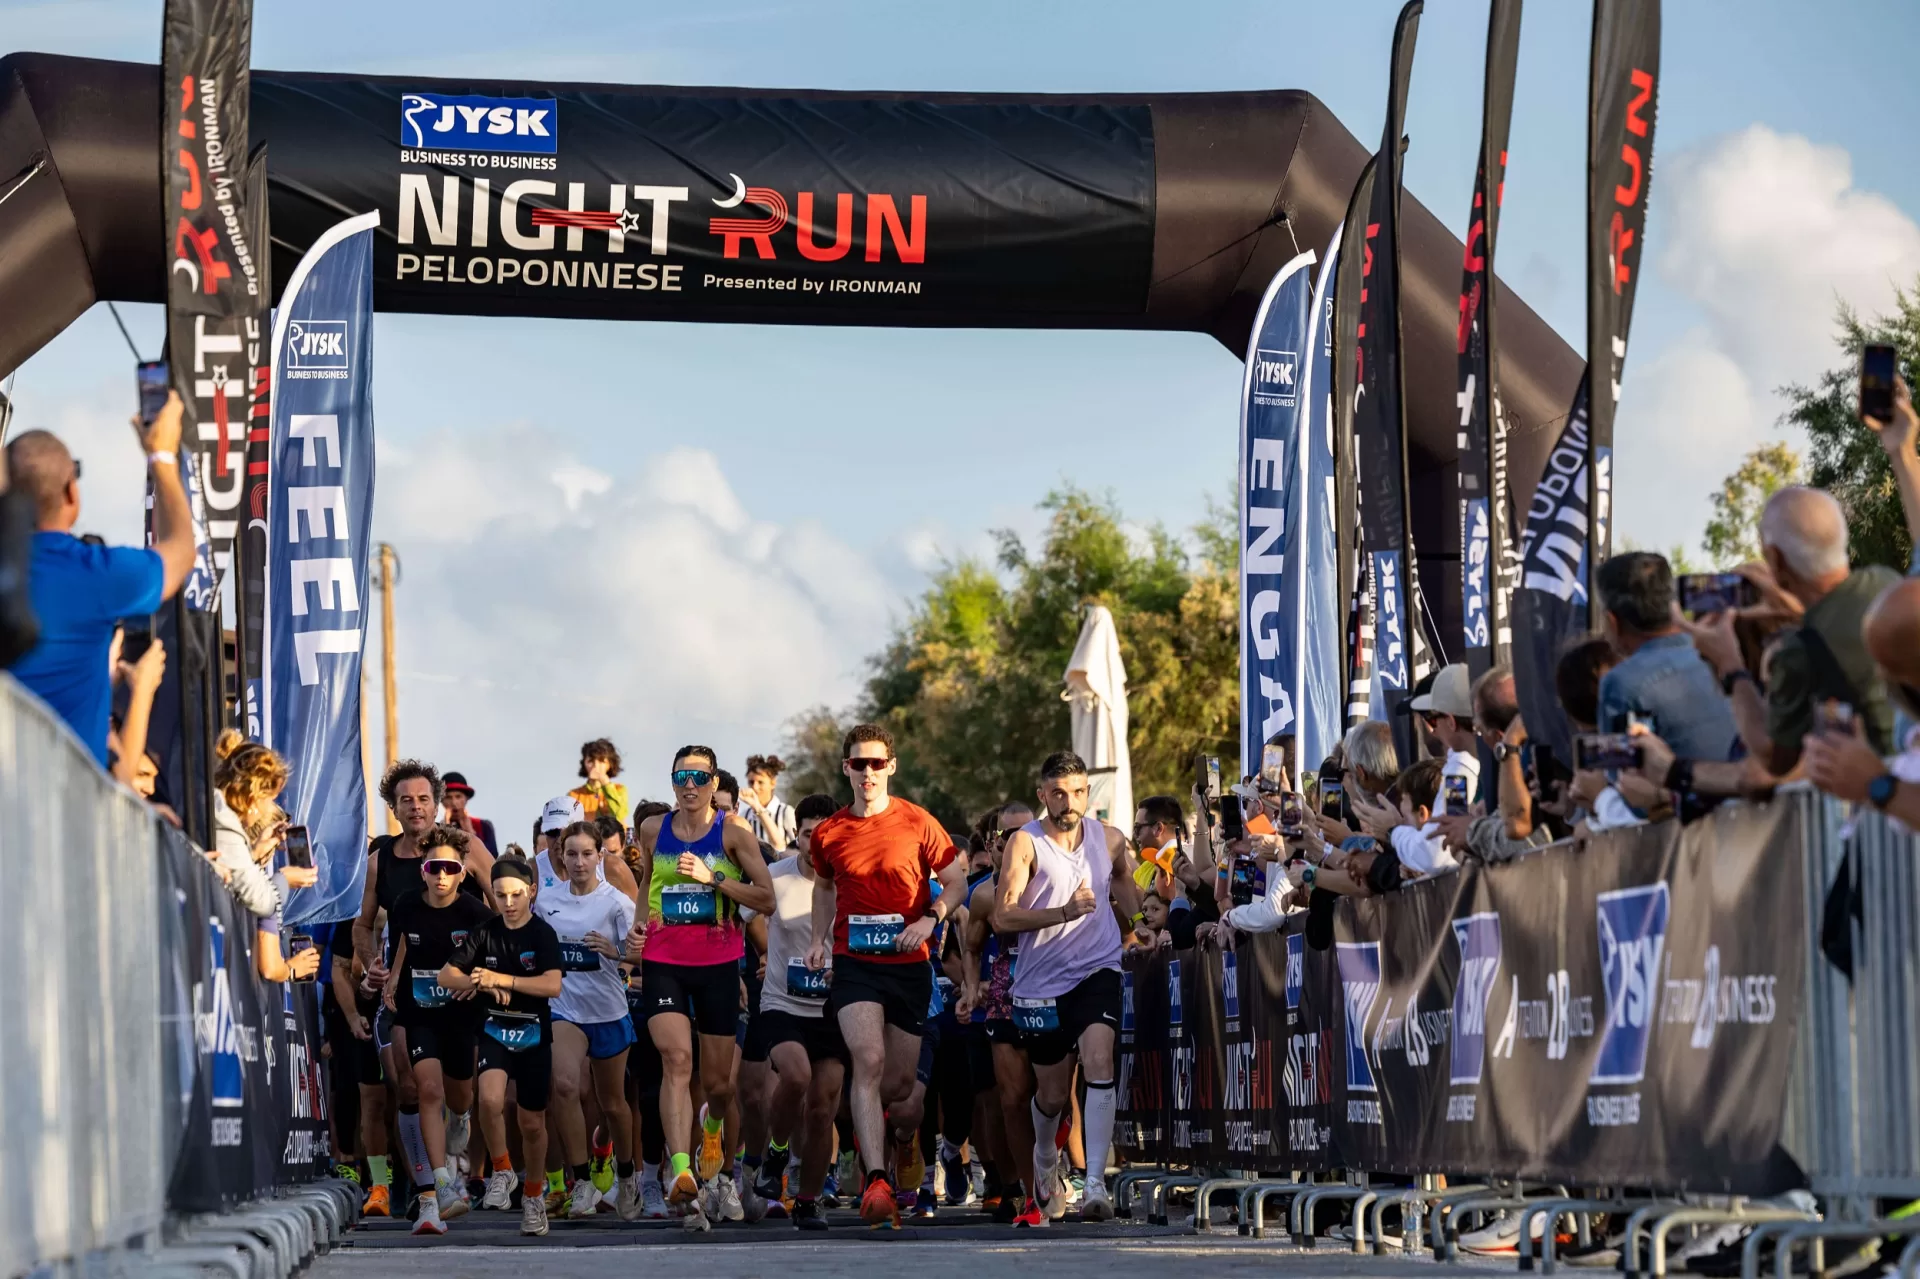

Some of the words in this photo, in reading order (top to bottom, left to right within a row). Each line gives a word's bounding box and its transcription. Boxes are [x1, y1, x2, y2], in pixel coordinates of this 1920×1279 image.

[200, 79, 227, 173] IRONMAN
[433, 105, 550, 137] JYSK
[400, 150, 467, 167] BUSINESS
[469, 154, 489, 168] TO
[491, 155, 557, 171] BUSINESS
[1609, 68, 1653, 296] RUN
[398, 173, 689, 256] NIGHT
[709, 186, 928, 264] RUN
[396, 253, 684, 292] PELOPONNESE
[703, 274, 797, 292] Presented
[802, 275, 824, 294] by
[829, 279, 922, 295] IRONMAN
[300, 332, 344, 356] JYSK
[288, 414, 361, 687] FEEL
[677, 901, 700, 914] 106
[865, 932, 889, 945] 162
[562, 950, 584, 962] 178
[804, 975, 827, 988] 164
[1023, 1016, 1044, 1028] 190
[501, 1029, 525, 1042] 197
